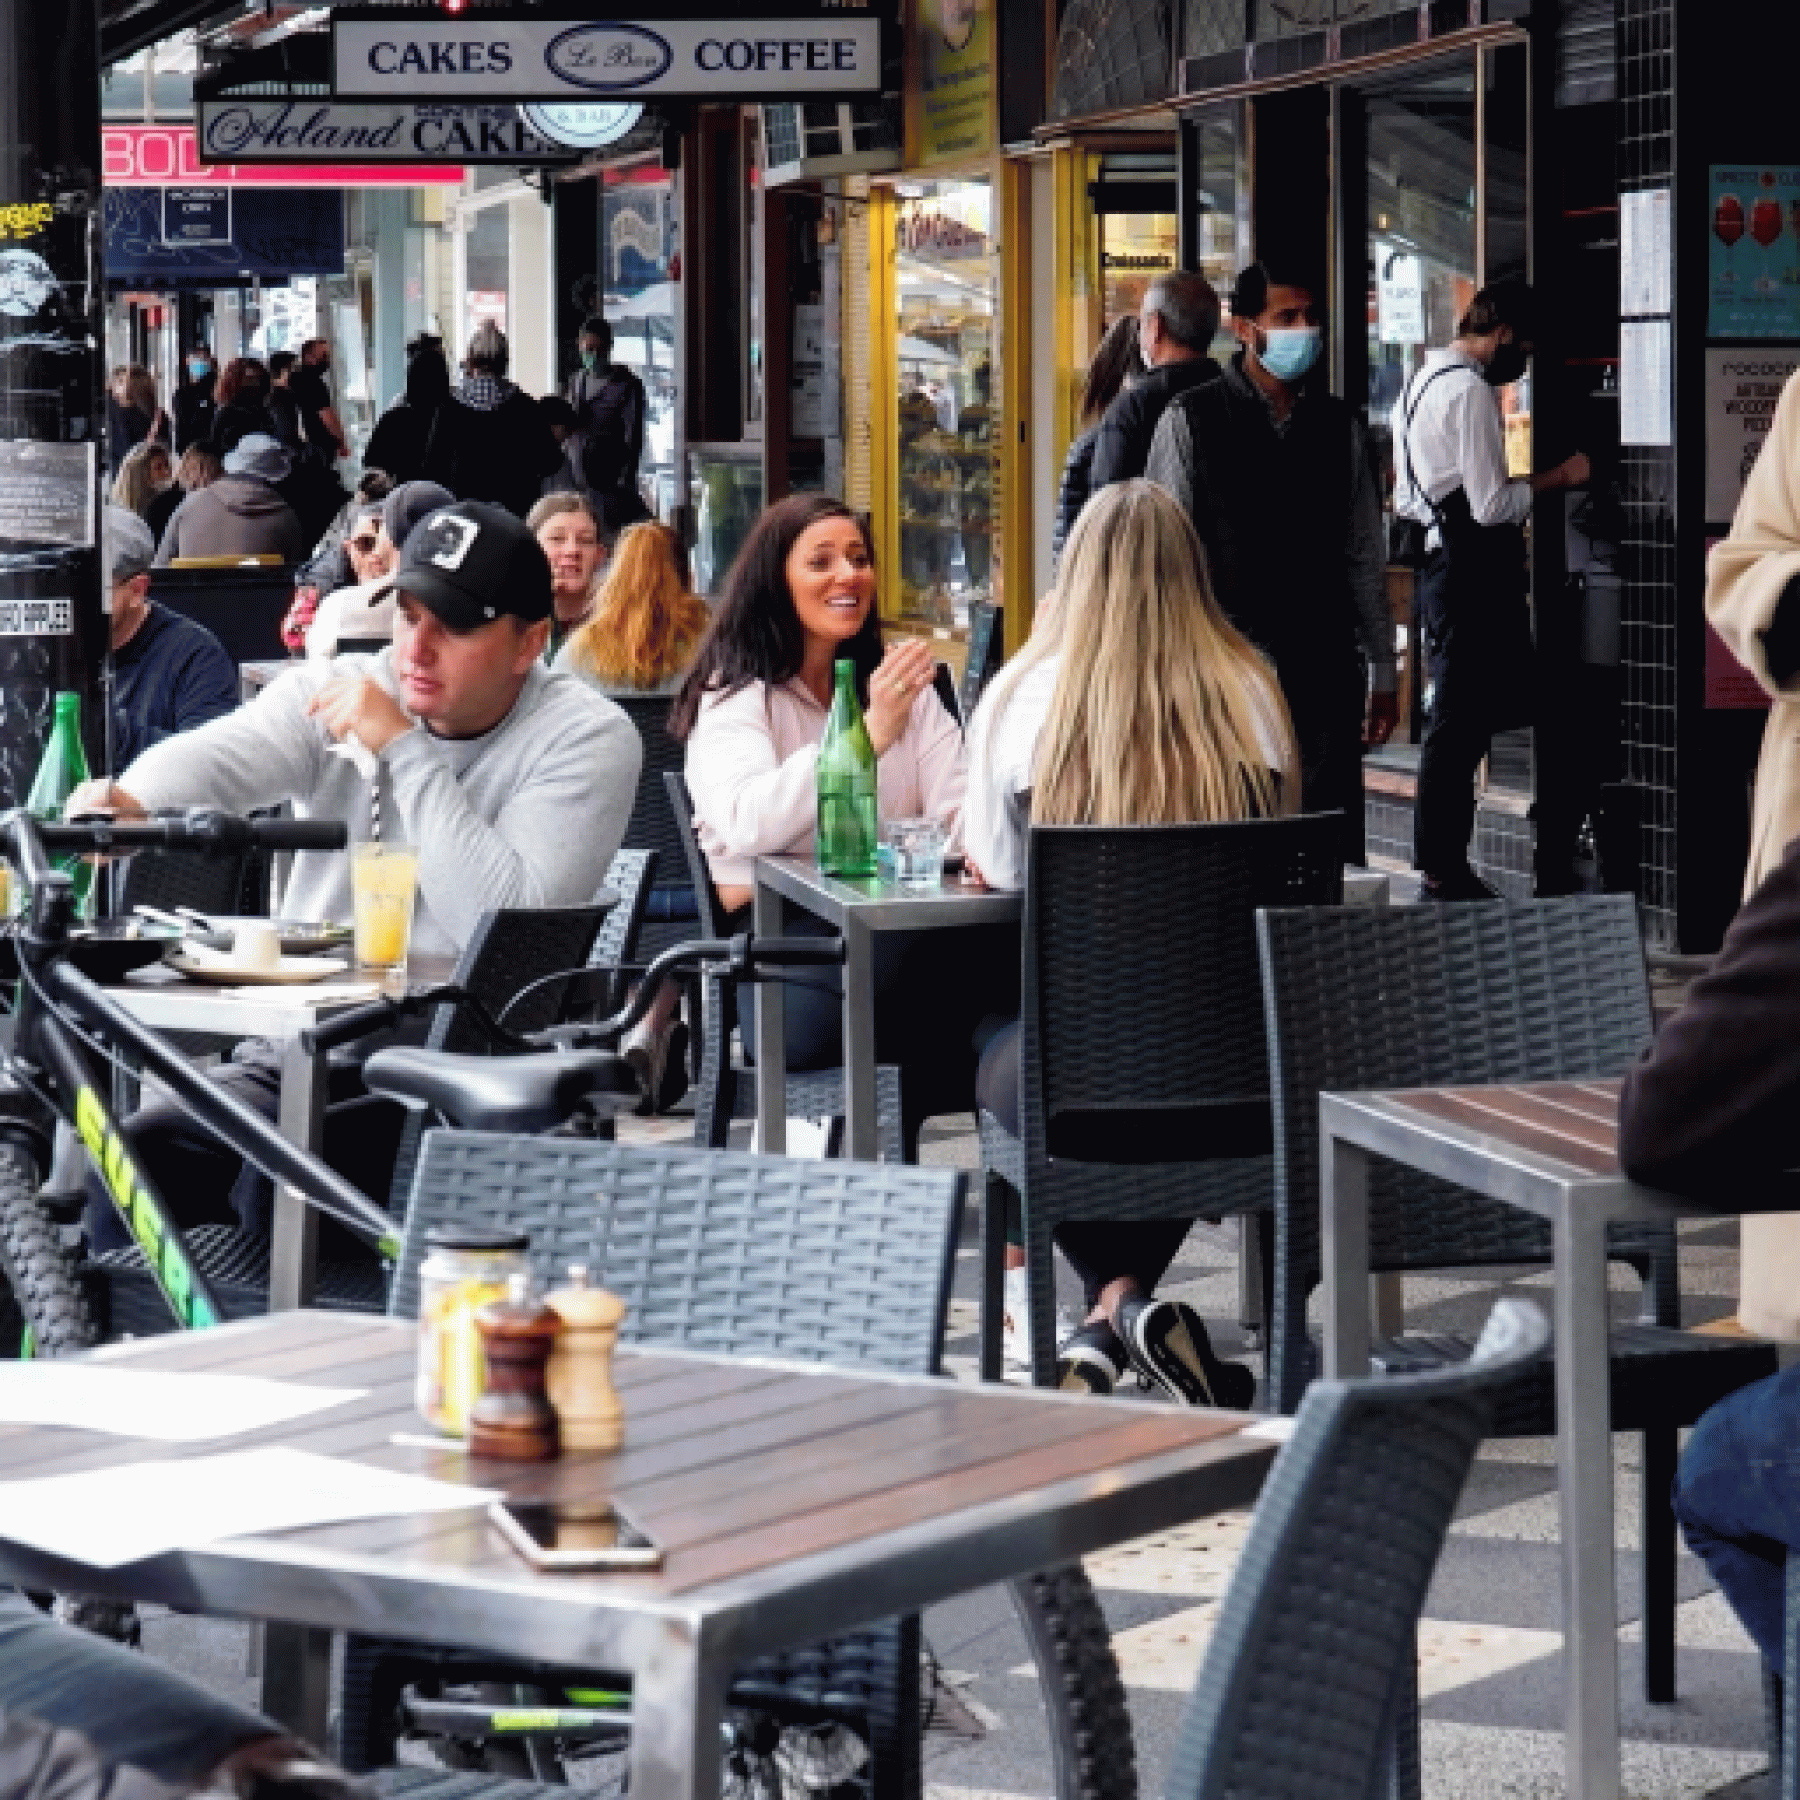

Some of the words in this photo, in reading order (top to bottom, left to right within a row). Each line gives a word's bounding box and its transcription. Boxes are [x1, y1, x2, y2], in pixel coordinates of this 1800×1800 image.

[368, 42, 513, 75] CAKES
[565, 42, 597, 67] Le
[695, 38, 857, 71] COFFEE
[206, 101, 405, 152] Acland
[411, 121, 556, 152] CAKE
[101, 132, 236, 177] BOD
